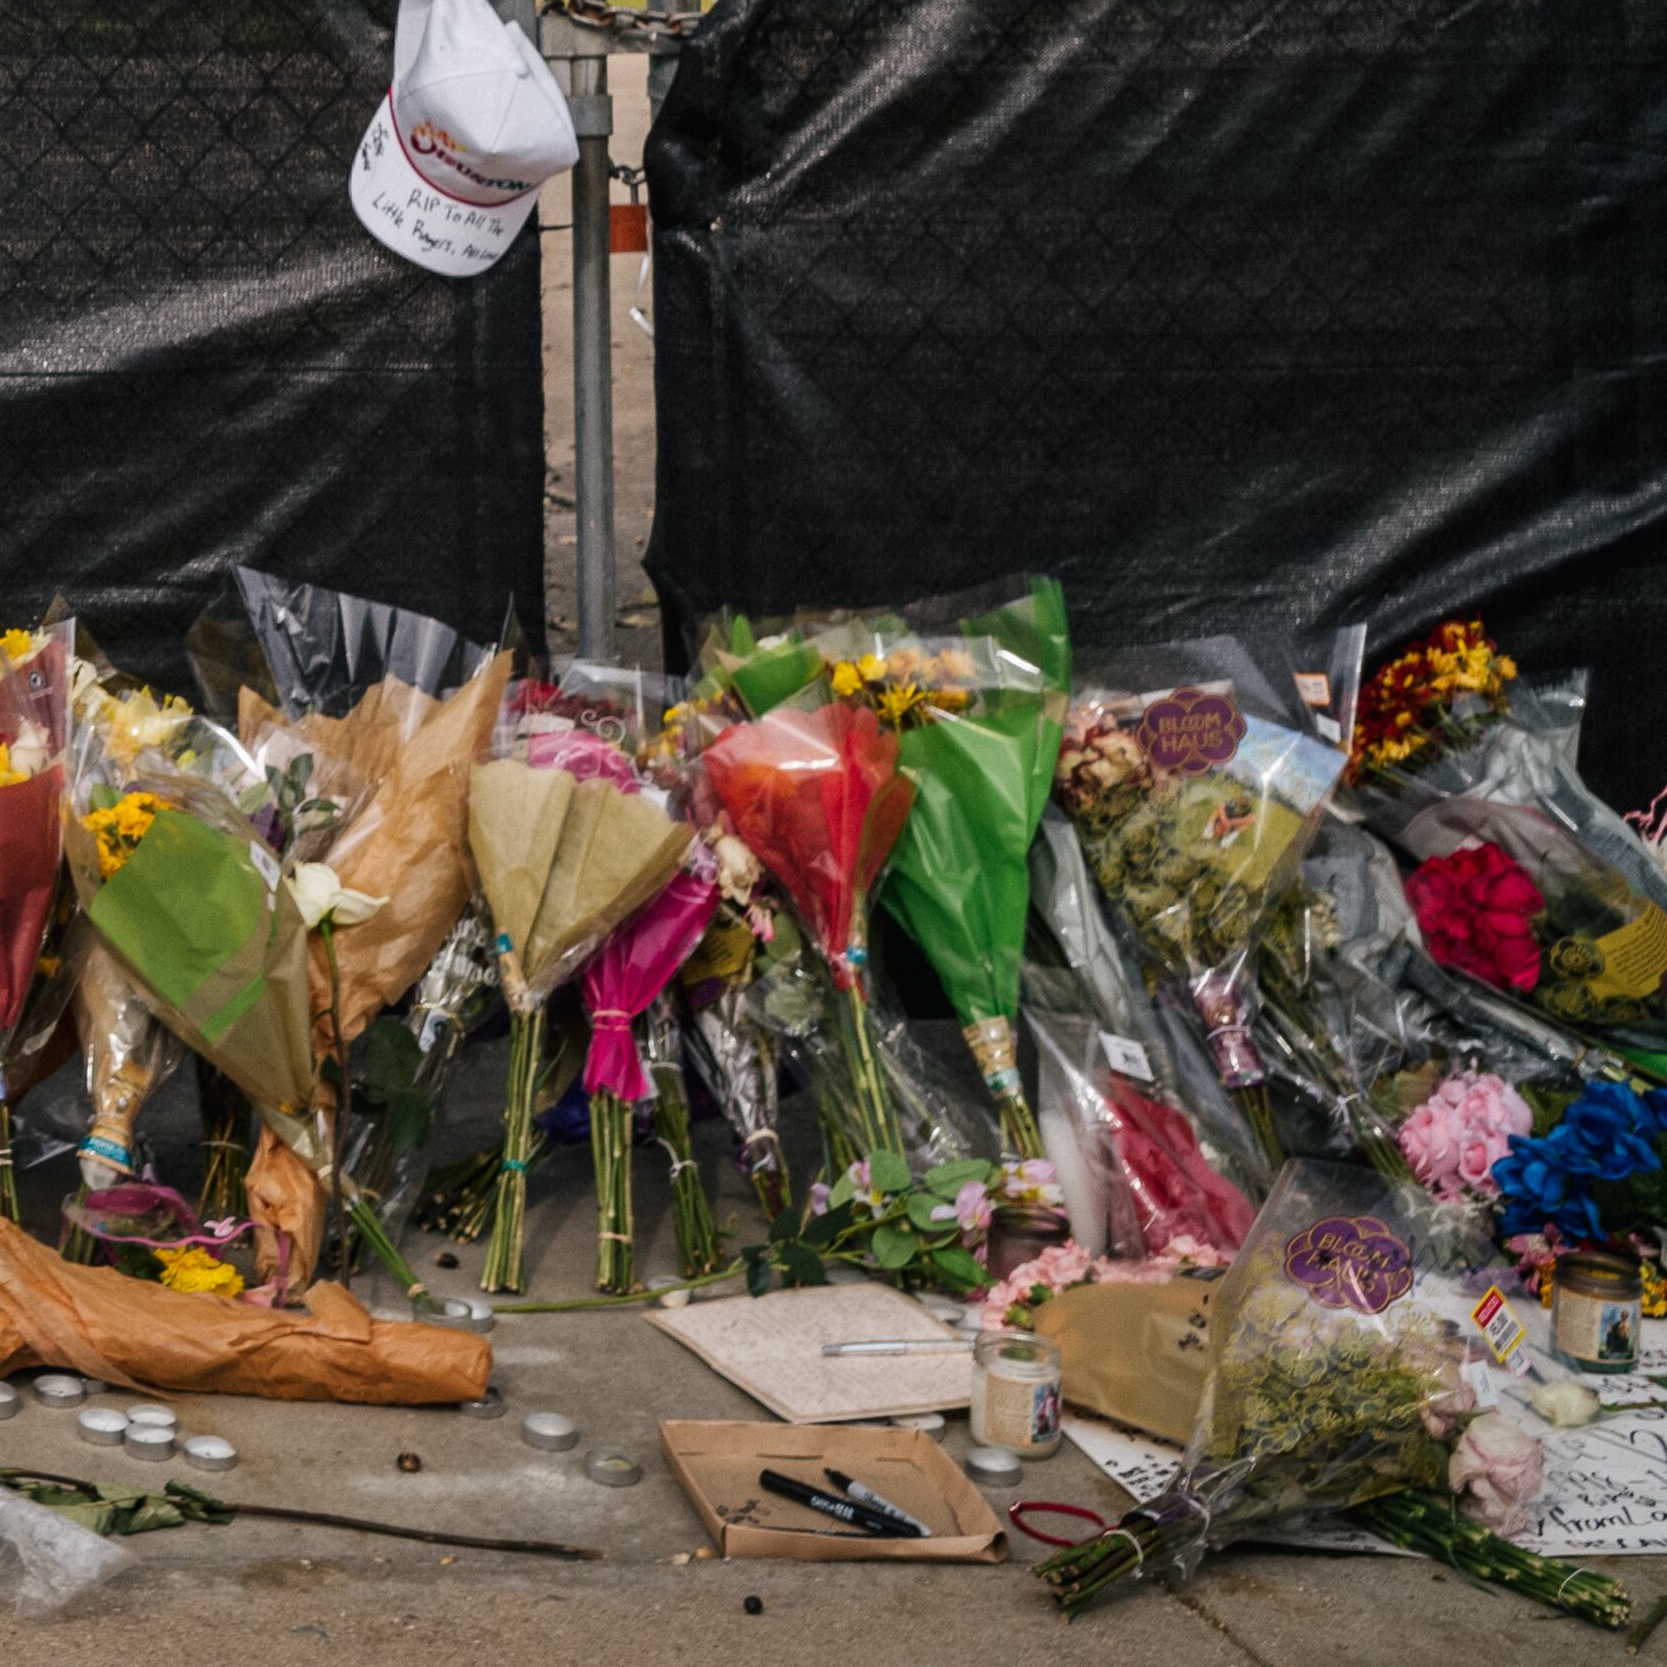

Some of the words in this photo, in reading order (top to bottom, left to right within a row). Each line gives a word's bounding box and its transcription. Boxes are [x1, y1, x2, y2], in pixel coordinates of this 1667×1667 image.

[406, 188, 441, 213] RIP
[1158, 710, 1222, 734] BLOOM
[1161, 729, 1224, 753] HAUS
